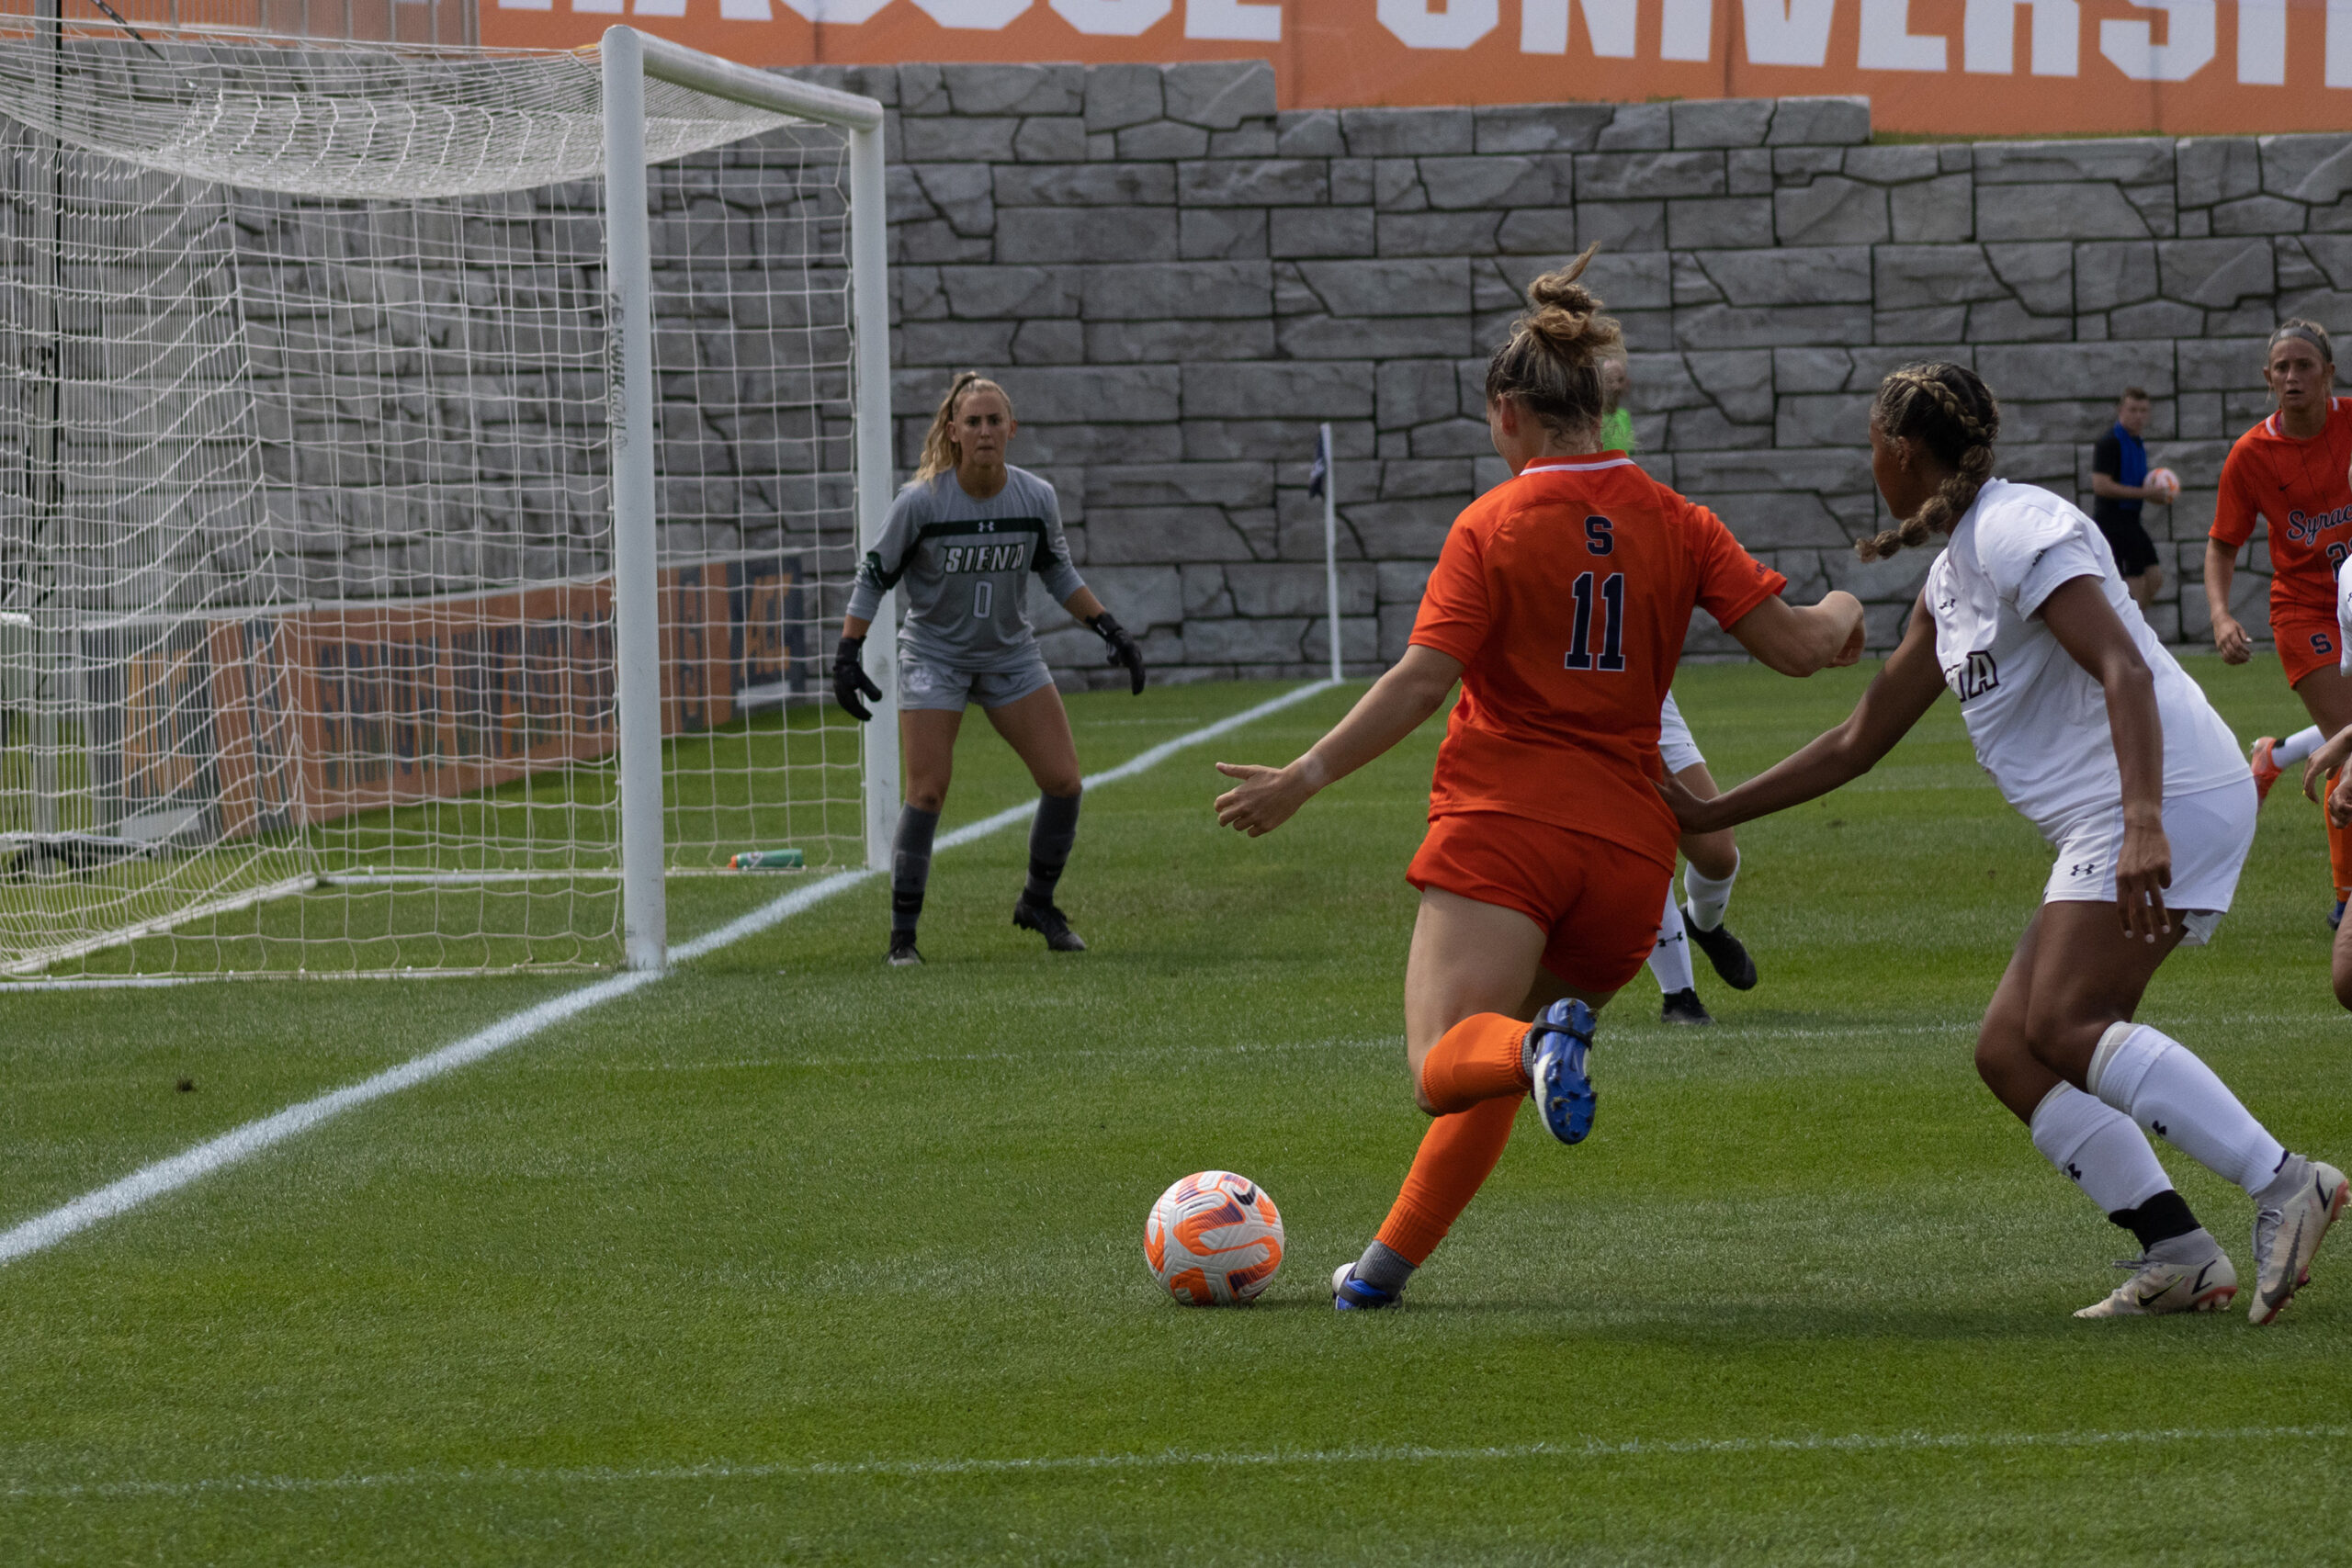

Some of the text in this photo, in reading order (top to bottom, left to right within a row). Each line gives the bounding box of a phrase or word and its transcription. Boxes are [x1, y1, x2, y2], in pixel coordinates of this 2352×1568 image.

[1584, 515, 1614, 557] S
[944, 542, 1026, 573] SIENA
[2325, 538, 2352, 581] 2
[973, 581, 993, 619] 0
[1564, 571, 1625, 671] 11
[2310, 632, 2334, 655] S
